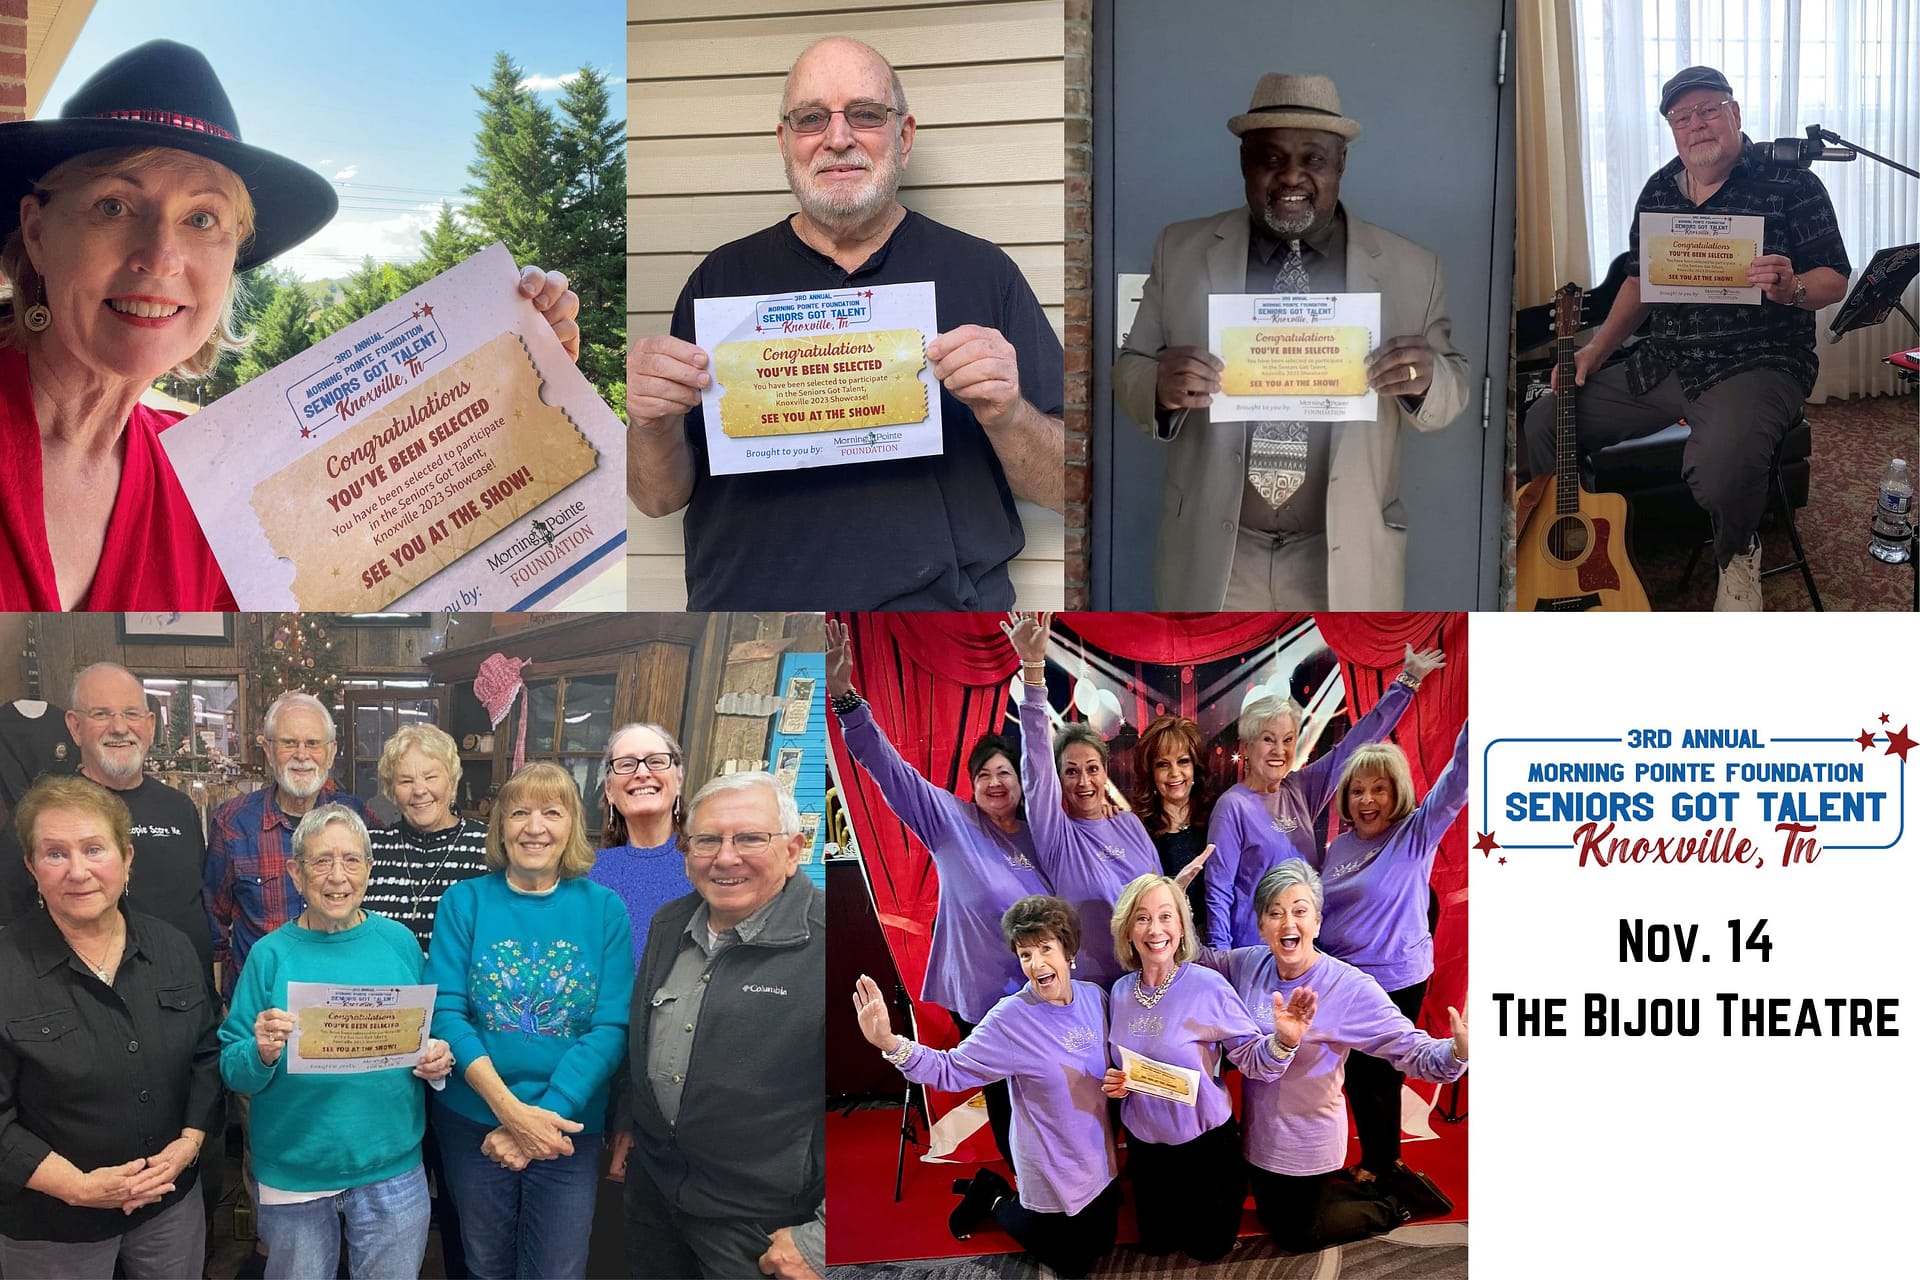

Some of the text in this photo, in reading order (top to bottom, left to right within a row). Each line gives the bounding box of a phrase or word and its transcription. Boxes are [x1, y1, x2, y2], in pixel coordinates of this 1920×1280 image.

[1673, 241, 1730, 250] Congratulations
[763, 307, 867, 323] SENIORS GOT TALENT
[768, 300, 860, 313] MORNING POINTE FOUNDATION
[782, 317, 849, 333] Knoxville, Tn
[334, 332, 384, 364] 3RD ANNUAL
[1256, 332, 1335, 345] Congratulations
[306, 325, 423, 399] MORNING POINTE FOUNDATION
[762, 342, 875, 363] Congratulations
[303, 331, 437, 419] SENIORS GOT TALENT
[756, 359, 882, 379] YOU'VE BEEN SELECTED
[336, 356, 425, 421] Knoxville, Tn
[753, 383, 766, 391] You
[767, 382, 785, 390] have
[787, 380, 805, 389] been
[807, 379, 837, 387] selected
[848, 375, 888, 385] participate
[784, 390, 797, 398] the
[798, 388, 826, 397] Seniors
[842, 385, 867, 394] Talent,
[775, 398, 809, 407] Knoxville
[761, 405, 885, 424] SEE YOU AT THE SHOW!
[326, 381, 471, 479] Congratulations
[834, 431, 903, 446] Morning Pointe
[327, 398, 489, 513] YOU'VE BEEN SELECTED
[746, 445, 823, 459] Brought to you by:
[841, 444, 898, 457] FOUNDATION
[332, 416, 506, 537] You have been selected to participate
[369, 450, 487, 531] in the Seniors Got Talent,
[373, 460, 496, 546] Knoxville 2023 Showcase!
[361, 466, 535, 590] SEE YOU AT THE SHOW!
[486, 501, 586, 572] Morning Pointe
[510, 523, 596, 587] FOUNDATION
[460, 586, 482, 606] by:
[750, 984, 788, 996] Columbia
